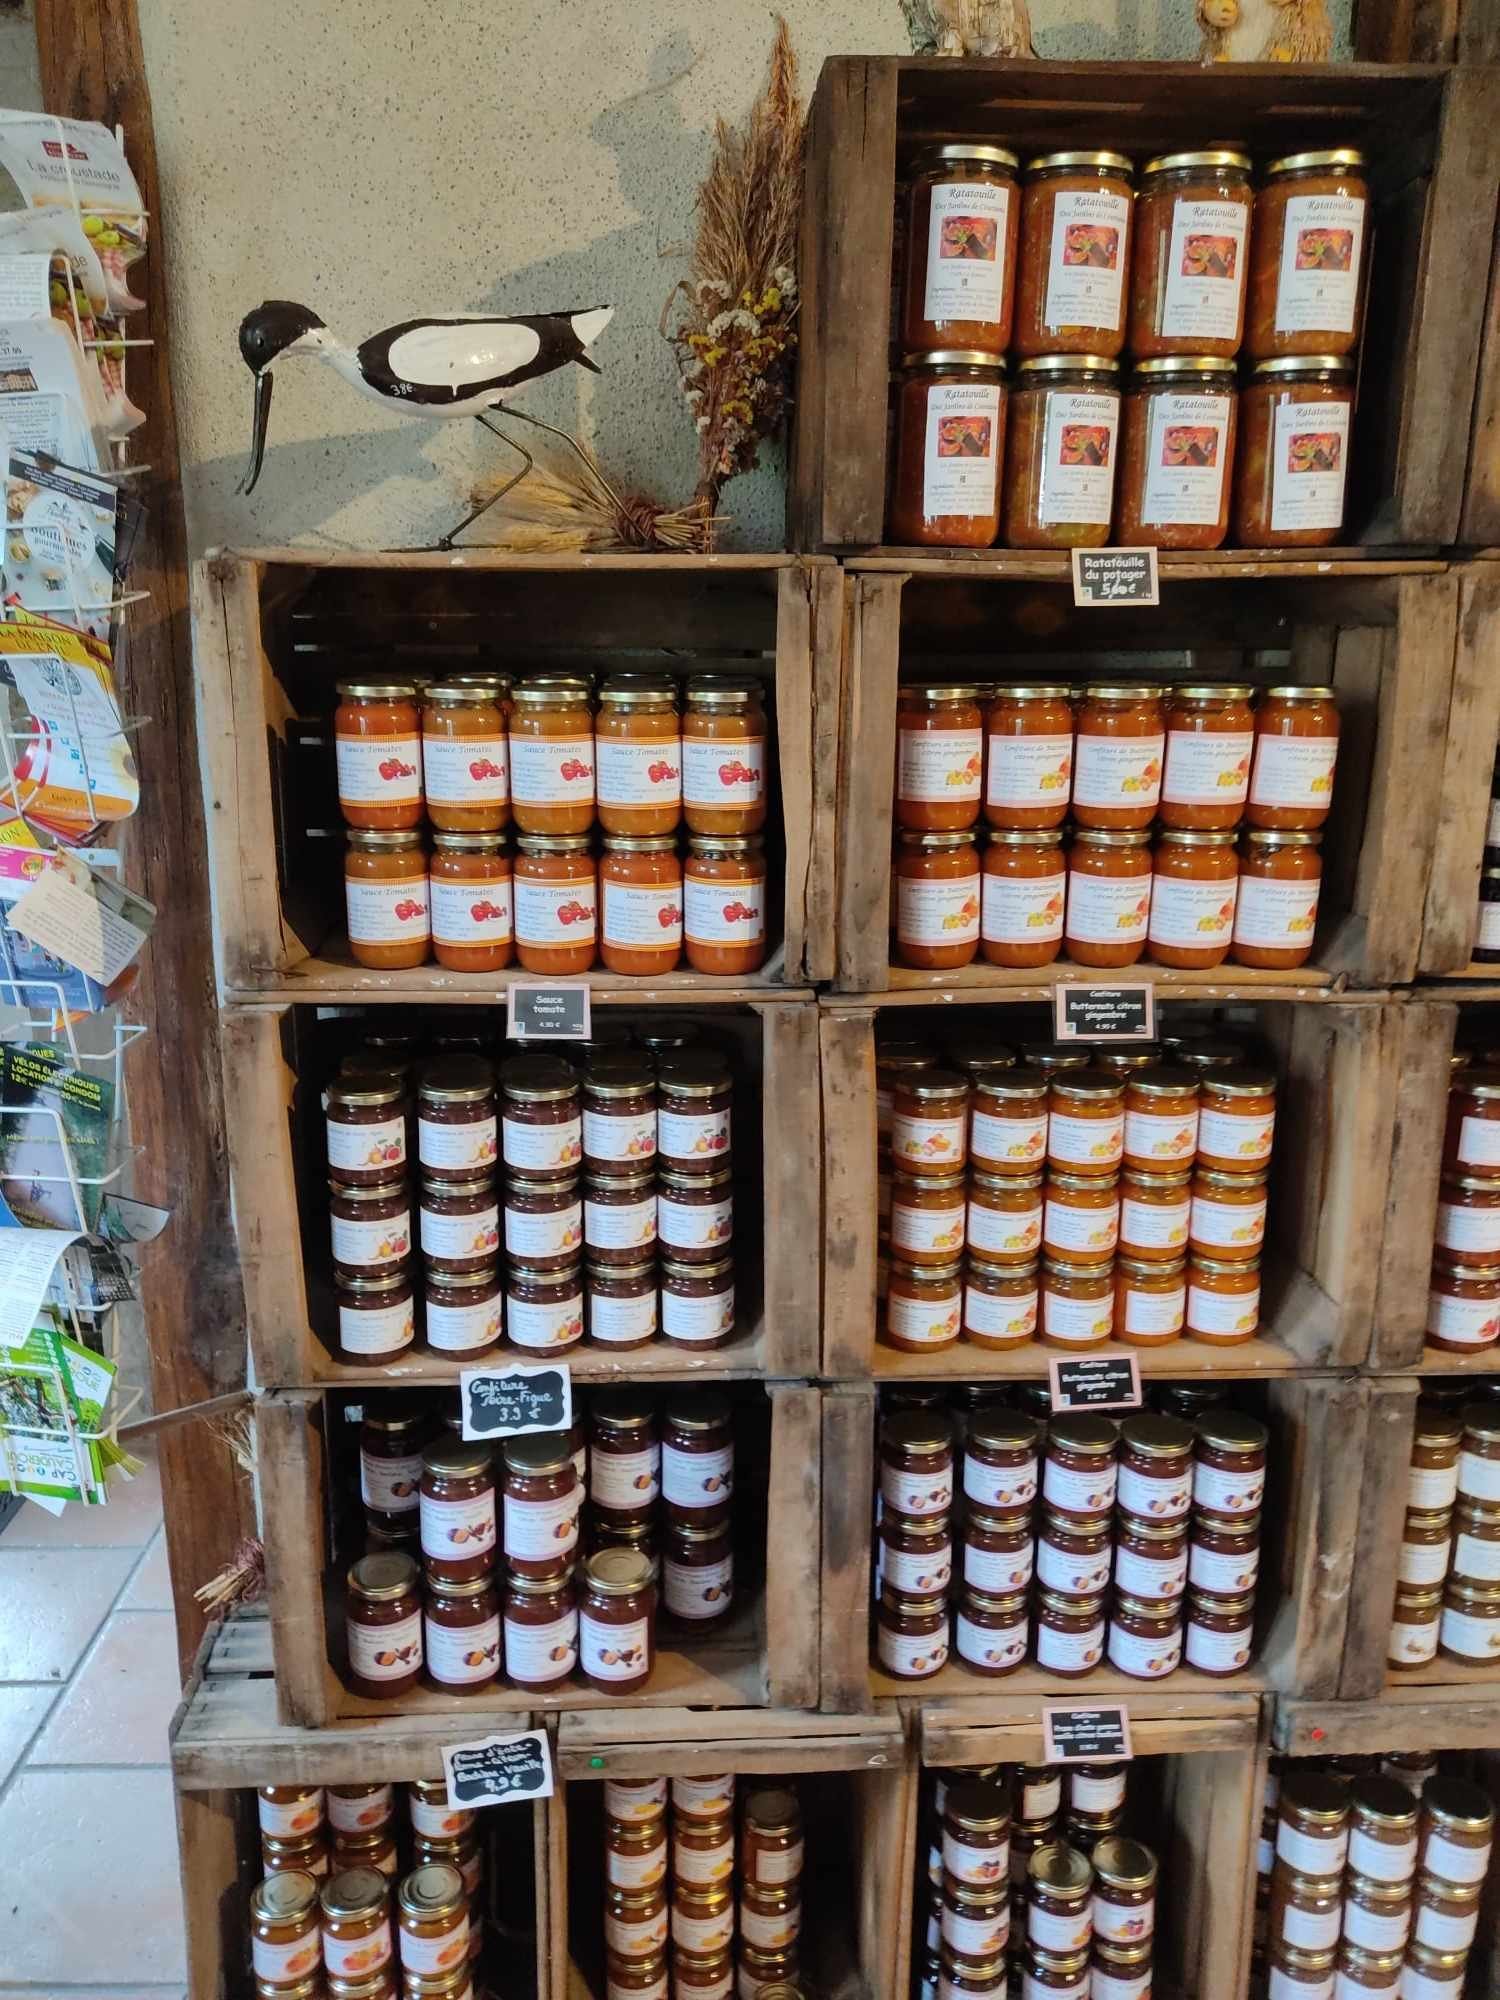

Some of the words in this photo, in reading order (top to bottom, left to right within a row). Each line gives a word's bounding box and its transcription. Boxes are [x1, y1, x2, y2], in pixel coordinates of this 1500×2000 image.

[949, 188, 997, 200] Ratatouille
[1073, 196, 1120, 209] Ratatouille
[1306, 199, 1354, 211] Ratatouille
[1192, 206, 1238, 218] Ratatouille
[944, 388, 990, 400] Ratatouille
[1069, 398, 1112, 409] Ratatouille
[1173, 399, 1219, 409] Ratatouille
[1295, 407, 1340, 418] Ratatouille
[1084, 557, 1145, 568] Ratatouille
[1085, 570, 1099, 580] du
[1102, 570, 1146, 581] potager
[344, 744, 365, 753] Sauce
[435, 744, 456, 753] Sauce
[524, 745, 545, 753] Sauce
[611, 747, 633, 755] Sauce
[689, 747, 708, 755] Sauce
[360, 888, 382, 897] Sauce
[438, 888, 457, 897] Sauce
[526, 889, 545, 897] Sauce
[626, 891, 648, 900] Sauce
[691, 888, 711, 896] Sauce
[471, 1380, 529, 1395] Confiture
